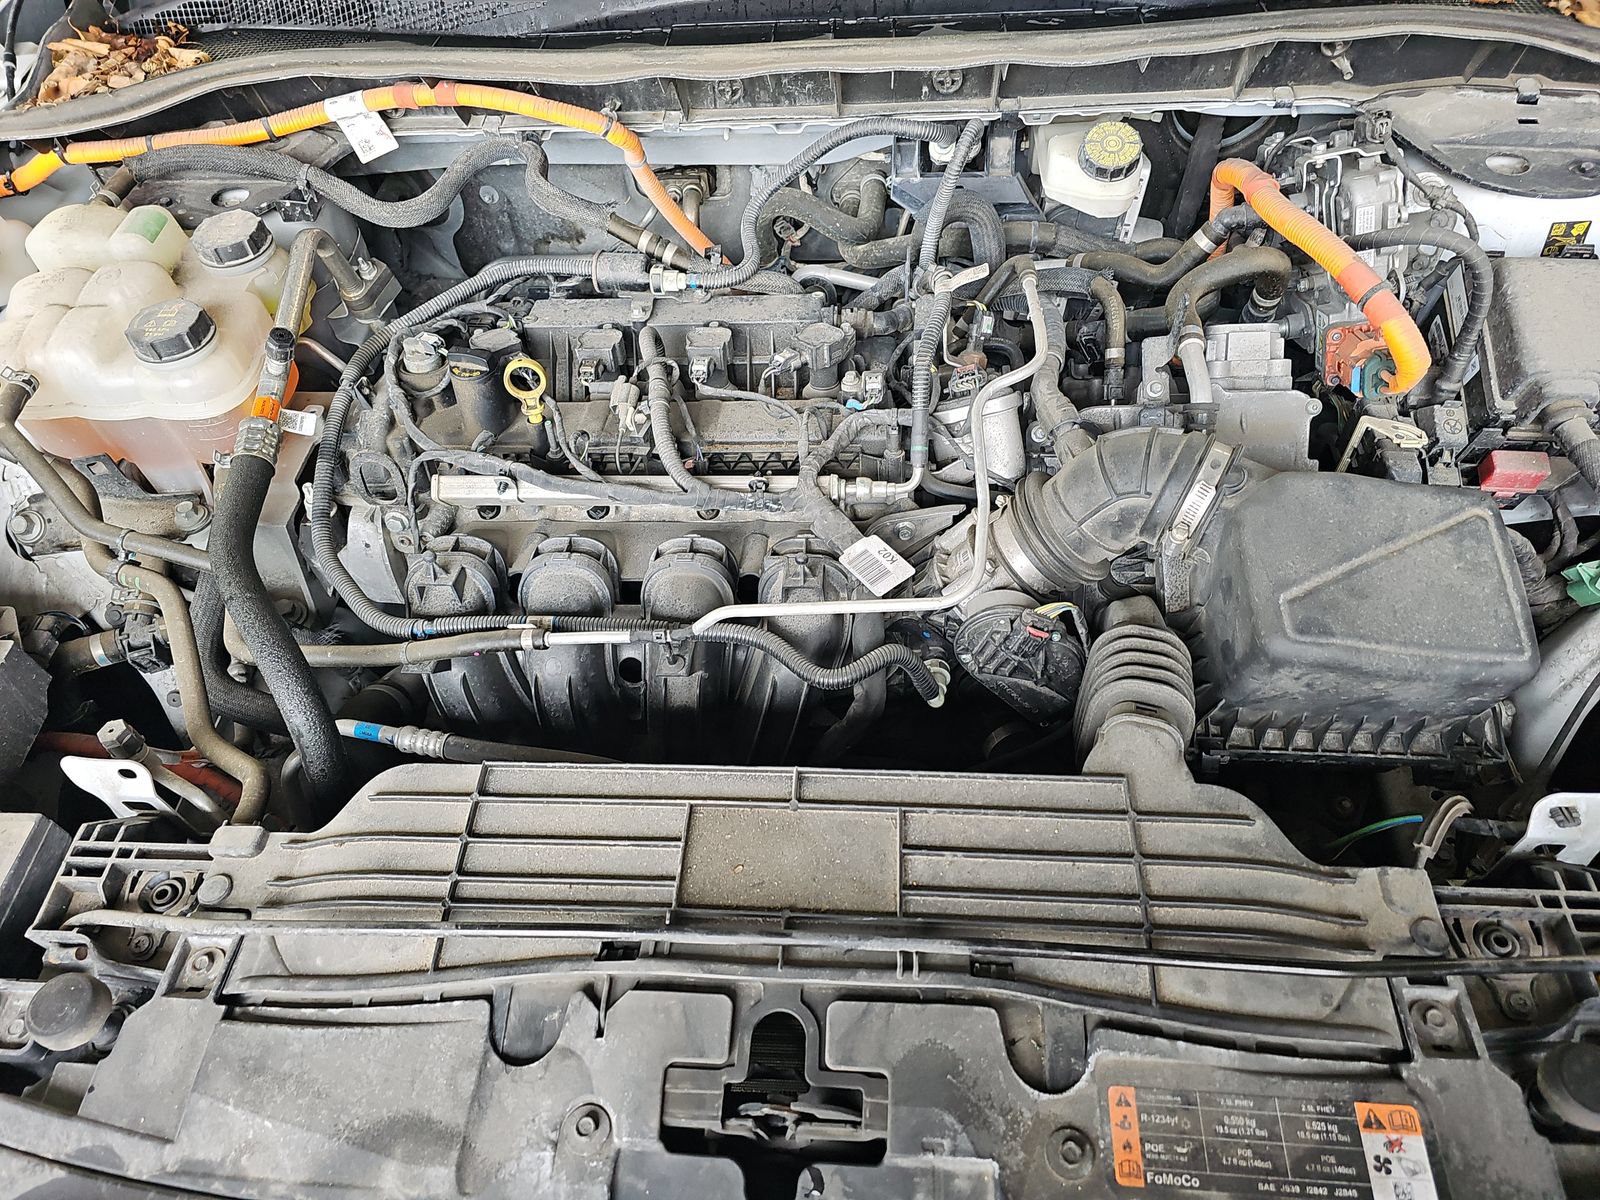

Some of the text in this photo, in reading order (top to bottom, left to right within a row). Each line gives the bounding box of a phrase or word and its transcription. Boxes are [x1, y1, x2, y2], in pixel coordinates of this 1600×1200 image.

[877, 547, 899, 565] K02
[1140, 1113, 1178, 1127] R-1234yf
[1245, 1117, 1257, 1129] kg
[1327, 1122, 1339, 1134] kg
[1144, 1142, 1165, 1153] POE
[1237, 1148, 1253, 1158] POE
[1320, 1154, 1337, 1164] POE
[1146, 1171, 1200, 1188] FoMoCo
